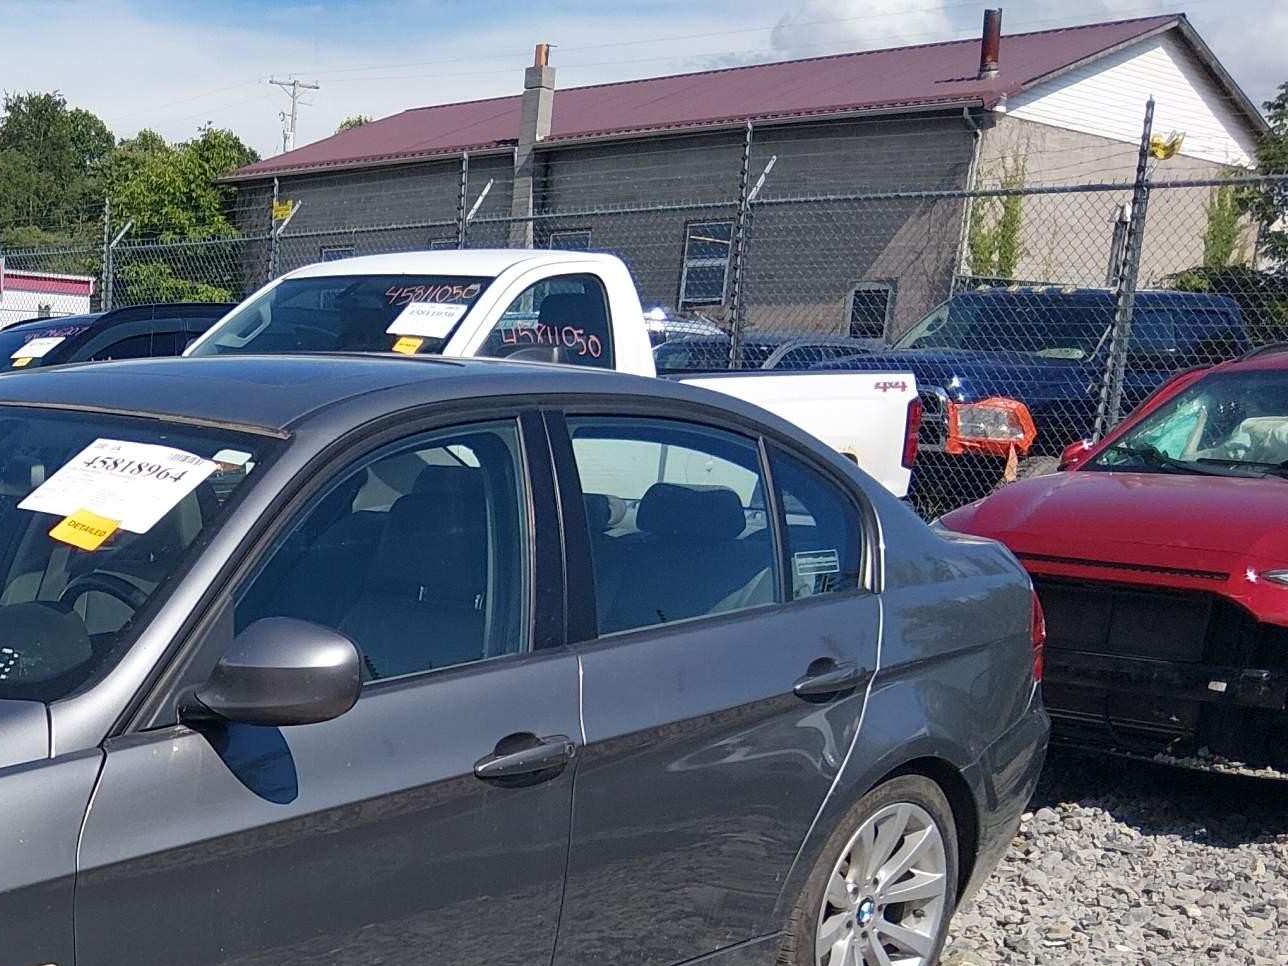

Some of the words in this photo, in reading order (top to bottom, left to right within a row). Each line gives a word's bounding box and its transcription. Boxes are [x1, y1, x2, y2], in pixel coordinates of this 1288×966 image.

[384, 284, 481, 306] 45811050
[500, 320, 602, 358] 45811050
[82, 454, 190, 484] 45818964
[67, 518, 107, 538] DETAILED
